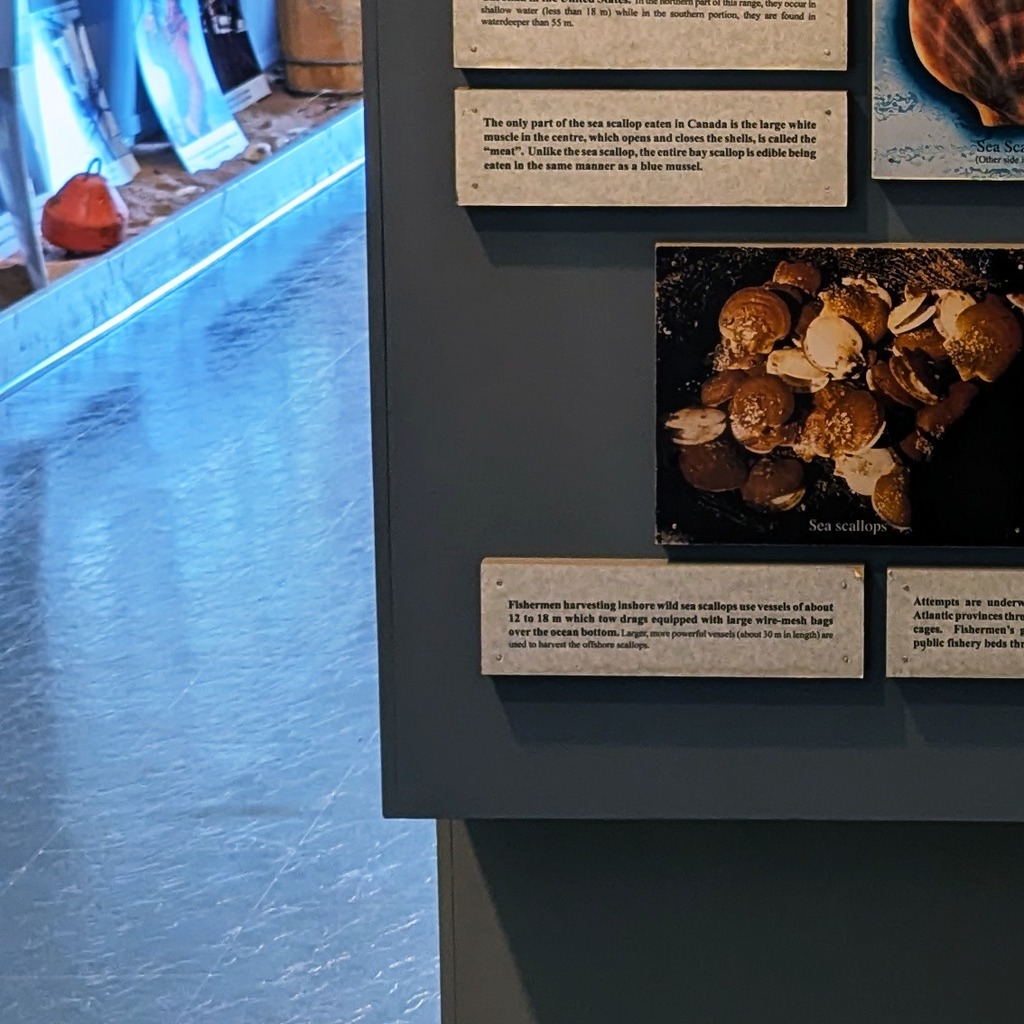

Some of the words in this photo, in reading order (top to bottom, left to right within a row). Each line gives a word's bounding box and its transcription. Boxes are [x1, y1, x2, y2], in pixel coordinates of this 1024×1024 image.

[484, 118, 503, 127] The
[505, 118, 528, 129] only
[531, 118, 553, 130] part
[555, 118, 567, 127] of
[568, 118, 585, 128] the
[587, 120, 603, 128] sea
[606, 118, 642, 130] scallop
[644, 119, 671, 128] eaten
[674, 119, 684, 128] in
[687, 119, 727, 128] Canada
[730, 119, 738, 129] is
[741, 119, 757, 129] the
[759, 119, 786, 131] large
[788, 120, 816, 129] white
[976, 140, 1000, 153] Sea
[975, 155, 1001, 165] (Other
[1003, 155, 1019, 164] side
[808, 519, 832, 532] Sea
[835, 518, 887, 534] scallops
[508, 599, 561, 609] Fishermen
[563, 600, 616, 612] harvesting
[617, 600, 655, 610] inshore
[656, 601, 678, 610] wild
[680, 602, 696, 610] sea
[697, 601, 737, 613] scallops
[739, 603, 756, 611] use
[757, 601, 790, 611] vessels
[792, 602, 804, 611] of
[802, 602, 833, 611] about
[913, 638, 944, 649] public
[947, 638, 981, 650] fishery
[984, 638, 1007, 648] beds
